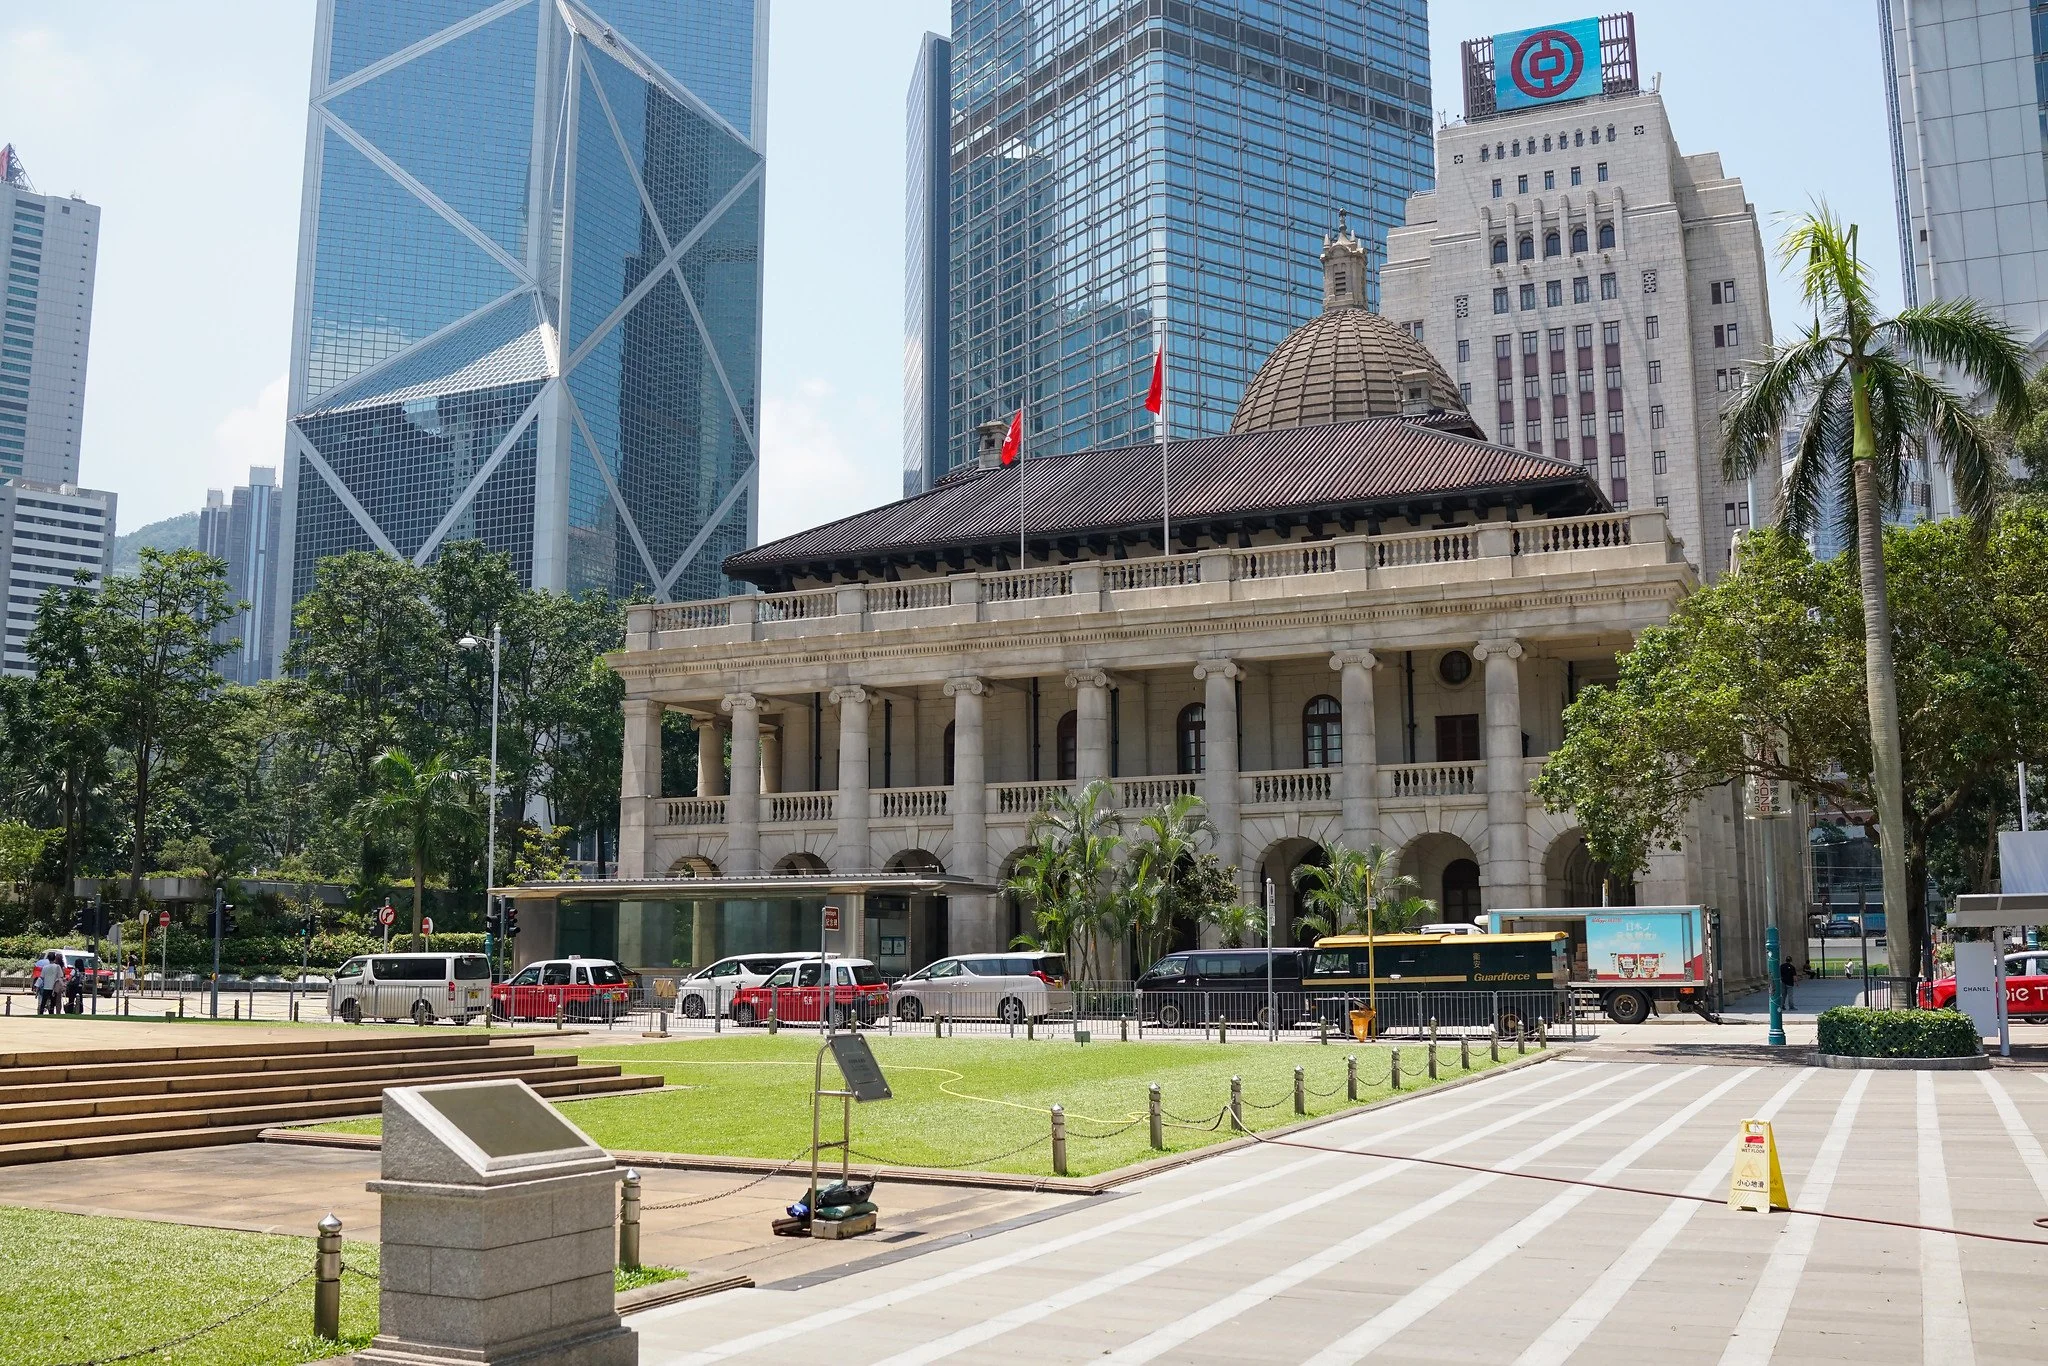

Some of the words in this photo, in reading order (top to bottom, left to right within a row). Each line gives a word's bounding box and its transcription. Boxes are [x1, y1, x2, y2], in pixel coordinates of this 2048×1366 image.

[1474, 973, 1530, 982] Guardforce
[1737, 1179, 1764, 1188] 小心地滑
